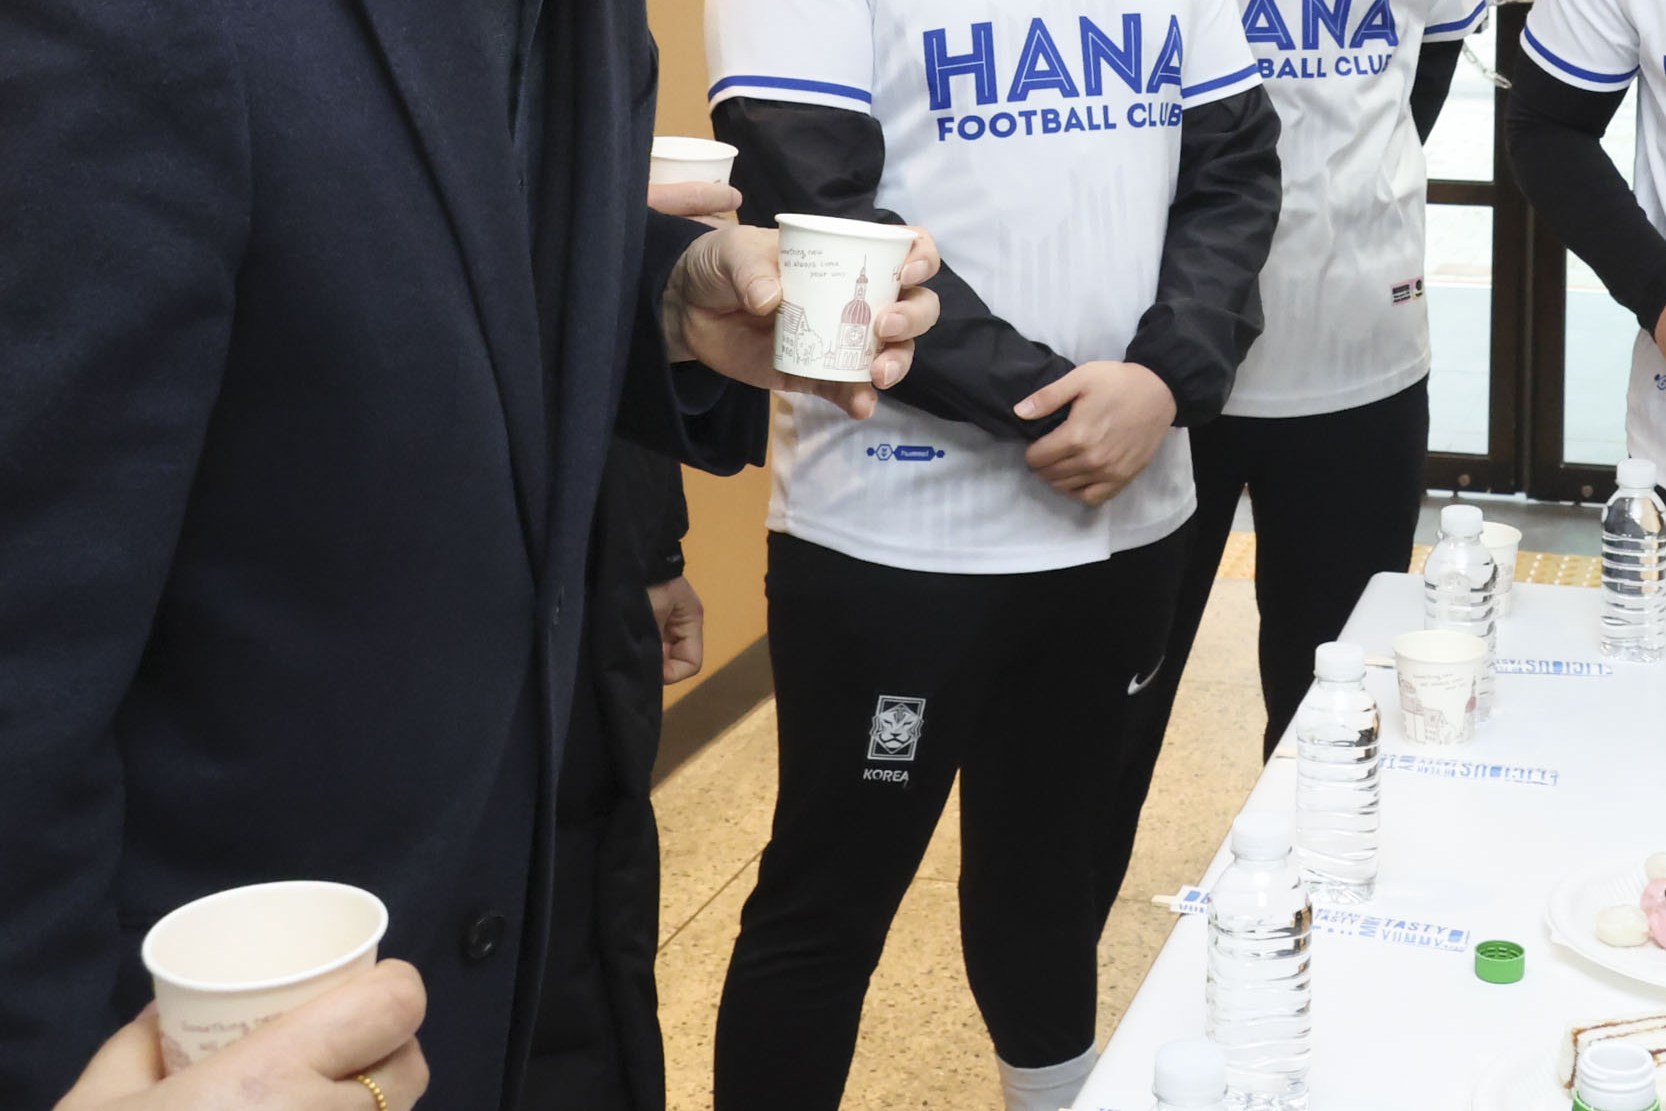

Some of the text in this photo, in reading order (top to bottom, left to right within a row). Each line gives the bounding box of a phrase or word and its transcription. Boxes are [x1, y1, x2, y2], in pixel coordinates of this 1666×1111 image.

[922, 13, 1184, 112] HANA
[937, 103, 1183, 142] FOOTBALL CLUB
[863, 768, 909, 783] KOREA
[1384, 918, 1448, 934] TASTY
